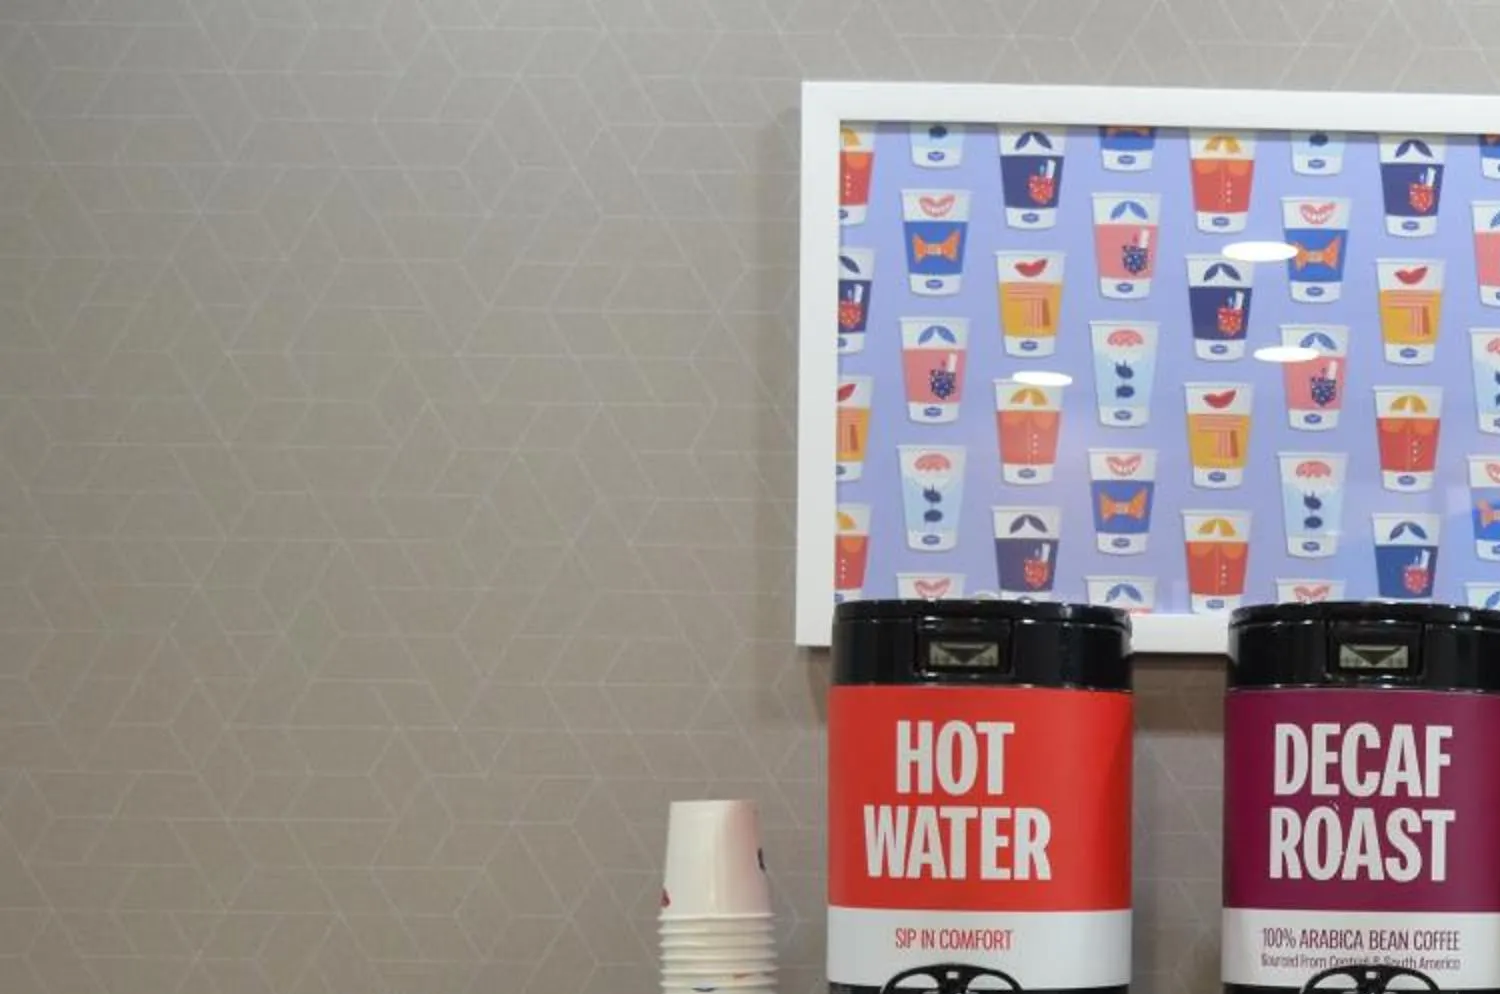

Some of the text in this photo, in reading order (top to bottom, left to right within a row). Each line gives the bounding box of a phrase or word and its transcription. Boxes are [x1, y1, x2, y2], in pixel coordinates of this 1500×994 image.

[896, 720, 1015, 796] HOT
[1274, 722, 1453, 798] DECAF
[863, 805, 1052, 881] WATER
[1269, 806, 1456, 882] ROAST
[895, 927, 1014, 950] SIP IN COMFORT
[1262, 927, 1461, 951] 100% ARABICA BEAN COFFEE
